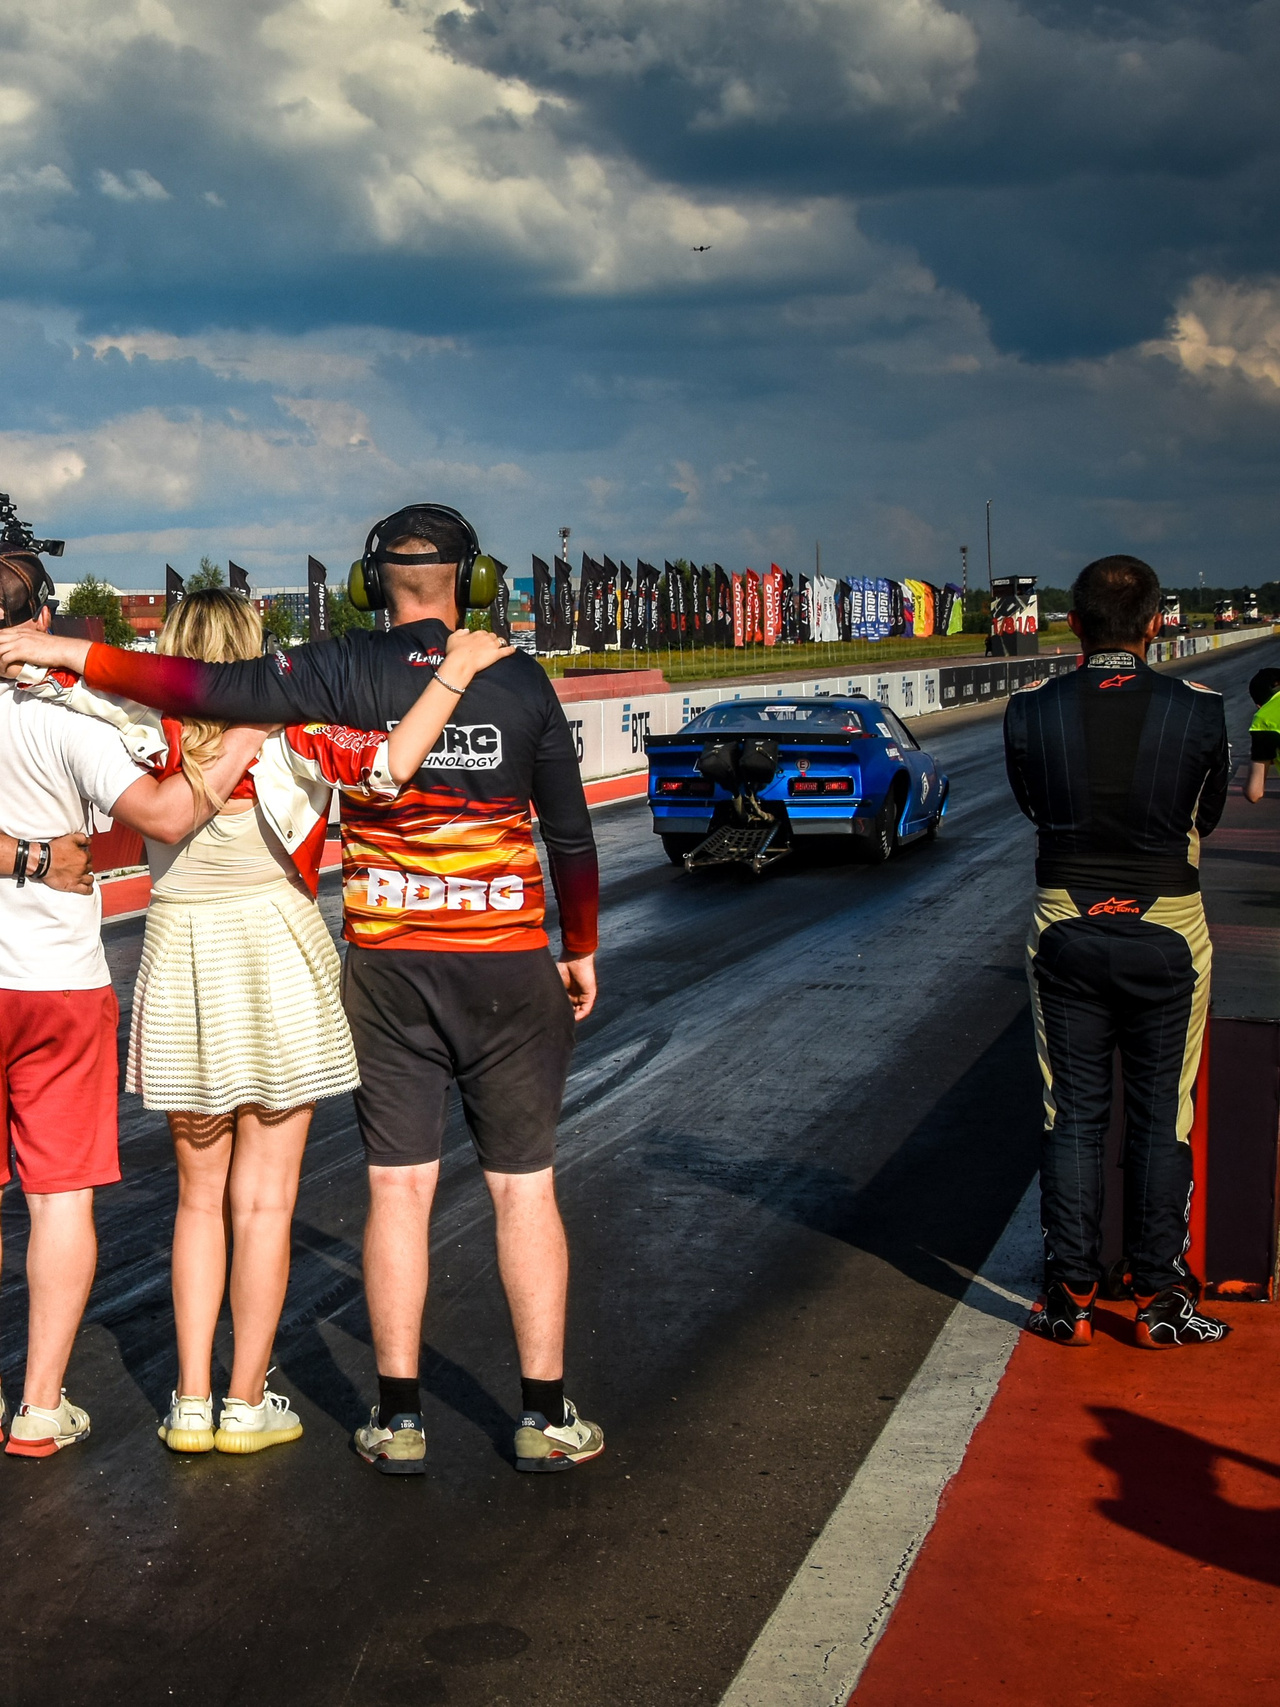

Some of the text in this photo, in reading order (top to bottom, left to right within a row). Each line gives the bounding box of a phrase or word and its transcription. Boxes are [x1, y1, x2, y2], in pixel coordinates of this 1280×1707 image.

[992, 616, 1015, 636] 1/8
[1016, 616, 1036, 636] 1/8
[429, 727, 498, 756] DRC
[569, 720, 583, 764] ТБ
[631, 711, 650, 754] ВТБ
[423, 756, 498, 768] HNOLOGY
[366, 867, 525, 911] RDRC
